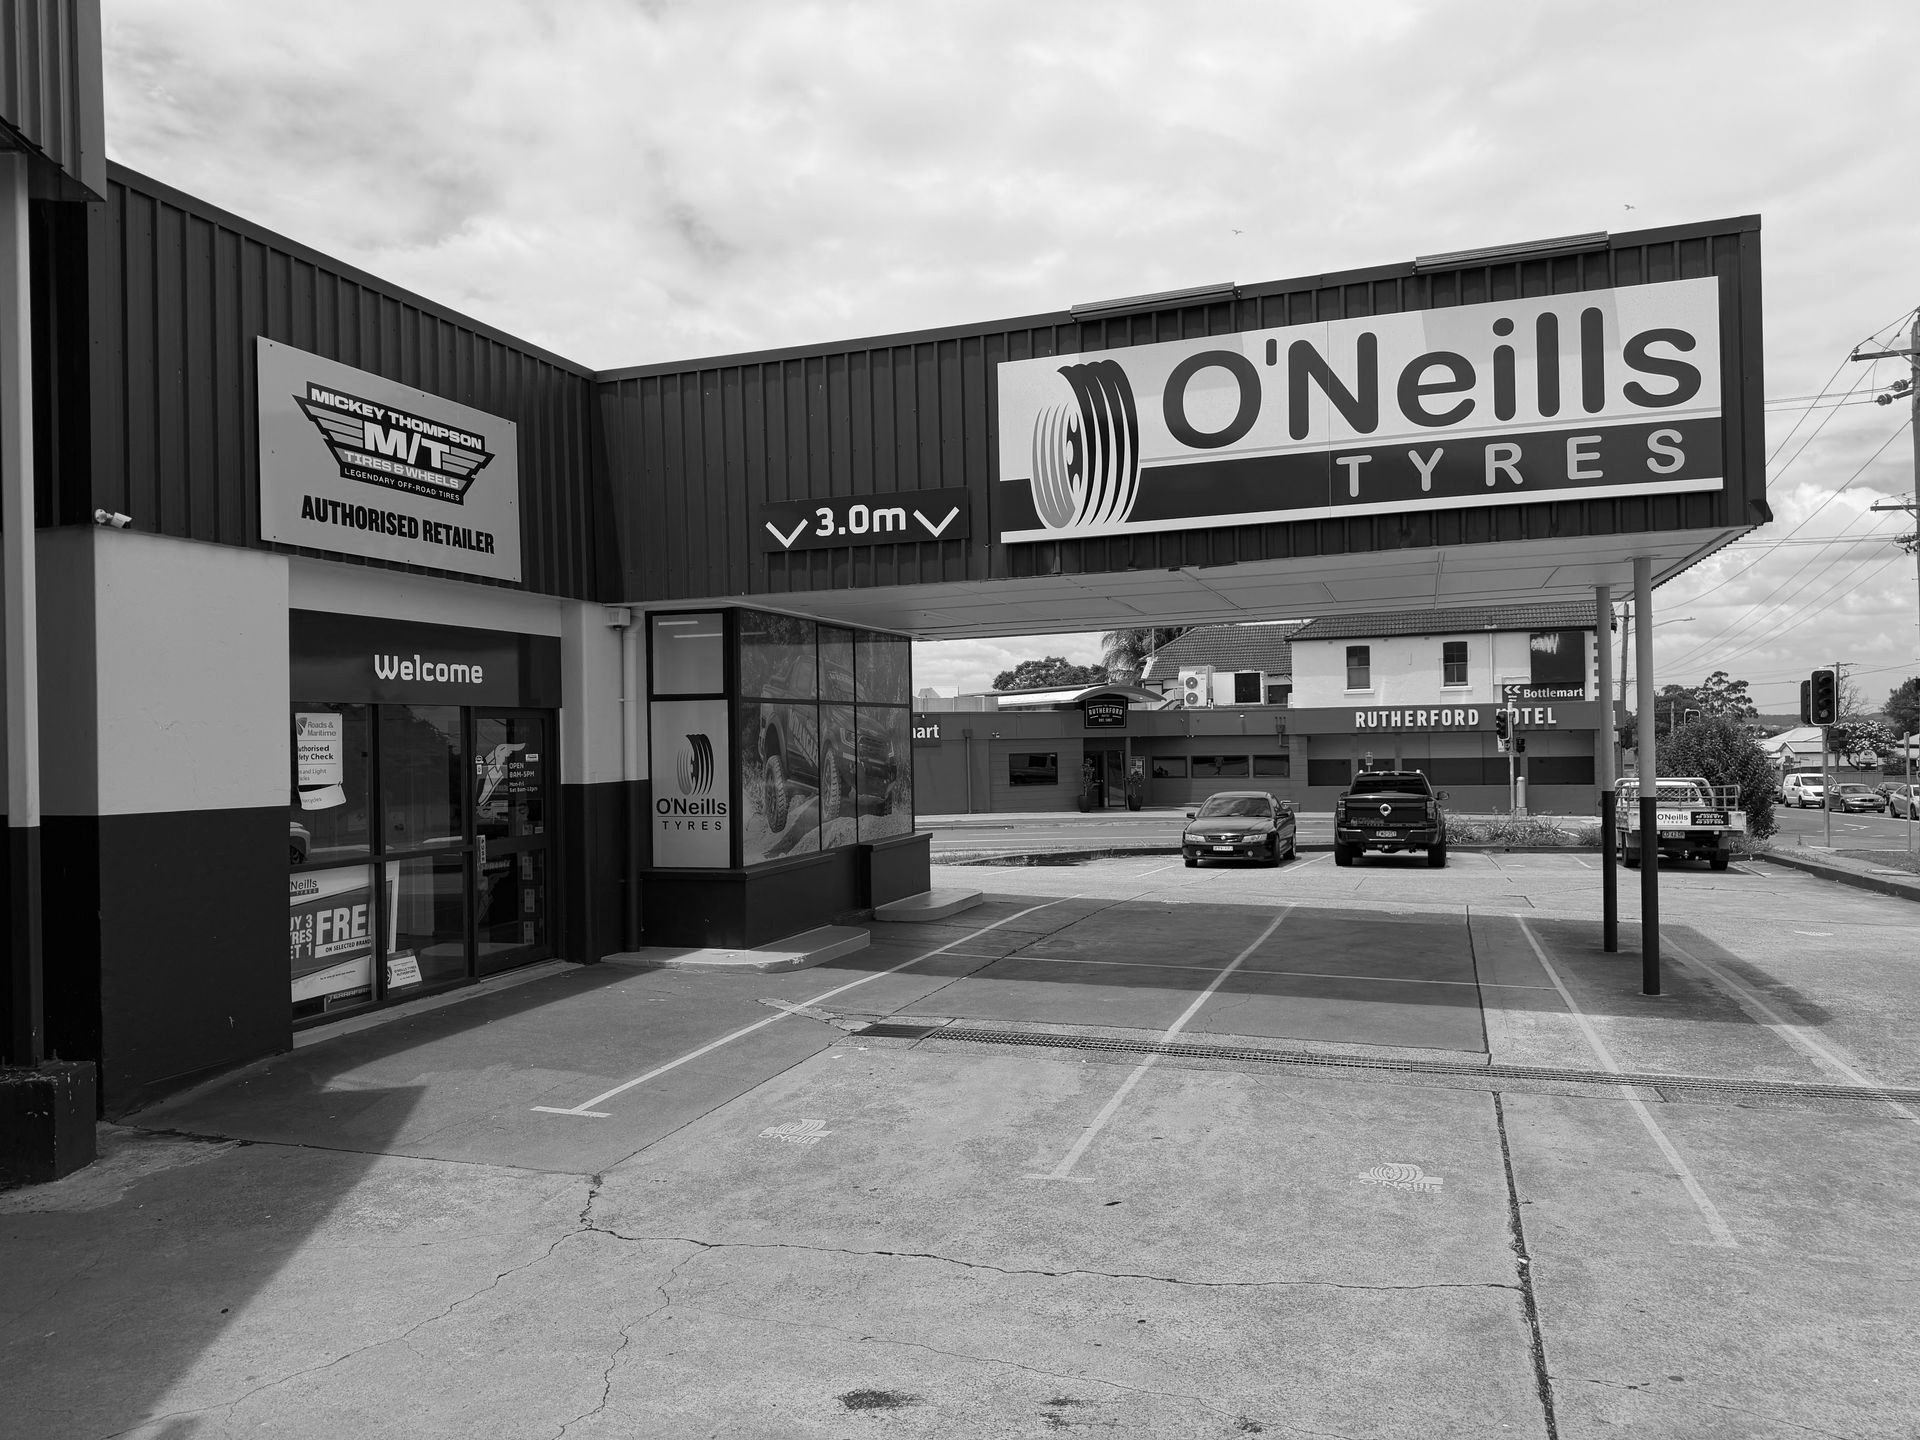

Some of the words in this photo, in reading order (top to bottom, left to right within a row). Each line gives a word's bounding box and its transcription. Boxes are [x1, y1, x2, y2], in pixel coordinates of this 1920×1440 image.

[1162, 306, 1703, 451] O'Neills
[311, 387, 385, 420] MICKEY
[388, 411, 482, 450] THOMPSON
[364, 421, 450, 470] M/T
[344, 451, 393, 472] TIRES
[394, 462, 406, 474] &
[405, 466, 460, 489] WHEELS
[1335, 428, 1687, 499] TYRES
[344, 467, 395, 486] LEGENDARY
[397, 479, 437, 496] OFF-ROAD
[438, 490, 461, 502] TIRES
[301, 495, 419, 539] AUTHORISED
[422, 519, 496, 555] RETAILER
[815, 504, 907, 537] 3.0m
[374, 654, 483, 684] Welcome
[1523, 687, 1584, 699] Bottlemart
[307, 721, 327, 729] Roads
[1355, 708, 1479, 728] RUTHERFORD
[307, 729, 337, 737] Maritime
[298, 744, 330, 752] uthorised
[310, 752, 334, 760] Check
[509, 762, 524, 770] OPEN
[656, 797, 727, 815] O'Neills
[662, 820, 722, 831] TYRES
[290, 879, 318, 891] Neills
[305, 914, 313, 928] 3
[316, 903, 371, 945] FRE
[306, 942, 312, 956] 1
[333, 941, 355, 951] SELECTED
